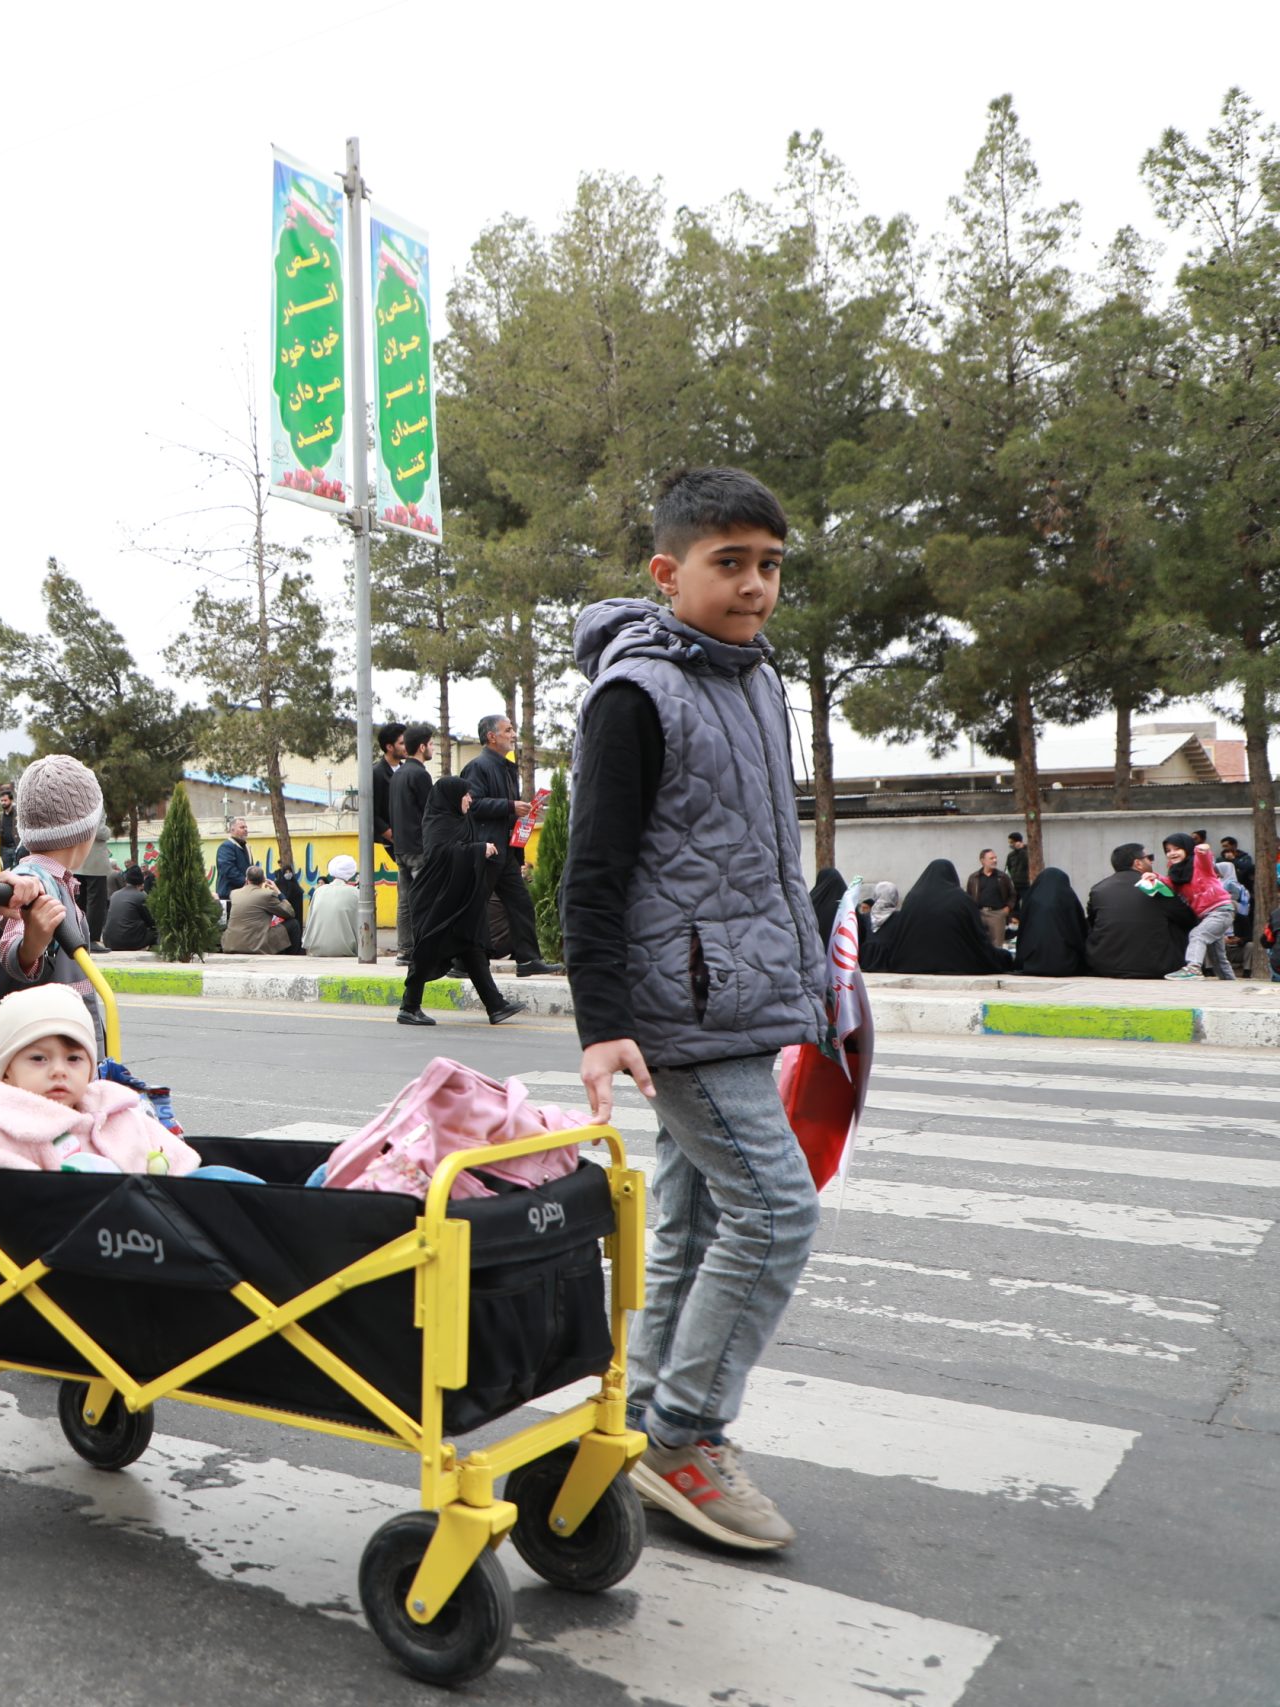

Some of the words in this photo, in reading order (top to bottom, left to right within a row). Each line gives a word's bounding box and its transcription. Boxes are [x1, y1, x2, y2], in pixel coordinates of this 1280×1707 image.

[286, 243, 331, 278] رقص
[283, 282, 338, 325] اندر
[378, 308, 385, 327] و
[385, 290, 420, 323] رقص
[281, 338, 305, 368] خود
[311, 326, 339, 358] خون
[384, 335, 421, 365] جولان
[289, 376, 341, 412] مردان
[385, 380, 414, 409] سر
[417, 373, 428, 395] بر
[296, 416, 334, 449] کنند
[391, 416, 429, 447] میدان
[396, 450, 426, 481] کنند
